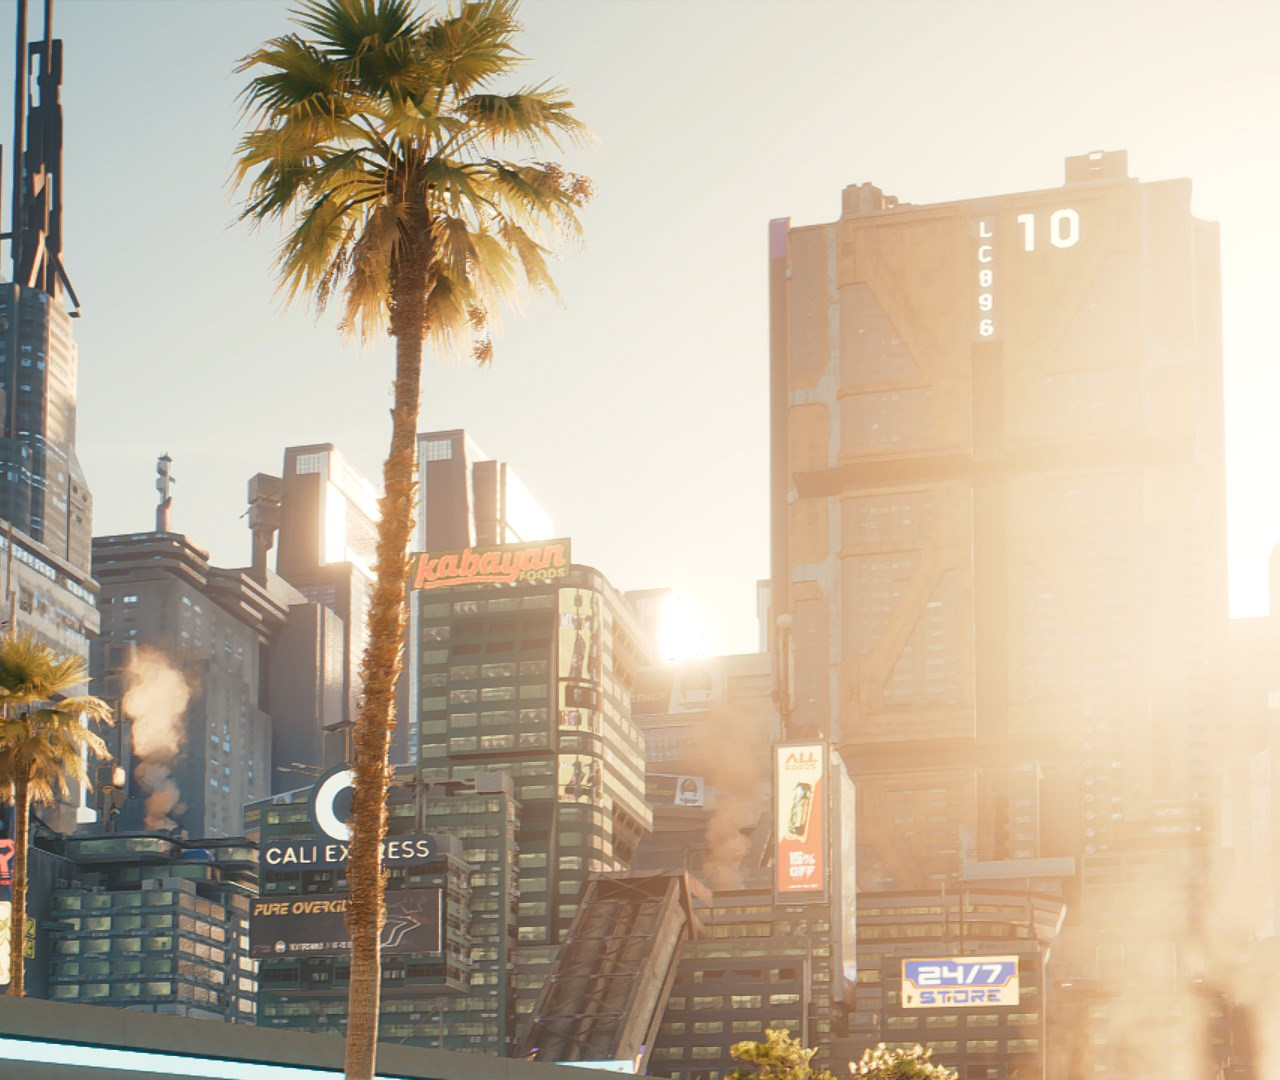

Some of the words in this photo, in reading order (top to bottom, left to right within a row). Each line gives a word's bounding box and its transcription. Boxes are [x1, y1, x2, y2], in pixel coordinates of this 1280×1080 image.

[1017, 208, 1081, 251] 10
[414, 544, 567, 588] kabayan
[520, 568, 566, 581] FOODS
[266, 846, 317, 865] CALI
[325, 840, 430, 863] EXESS
[789, 851, 816, 865] 15%
[789, 866, 816, 877] OFF
[254, 902, 289, 916] PURE
[917, 964, 1003, 986] 24/7
[919, 989, 1001, 1004] STORE
